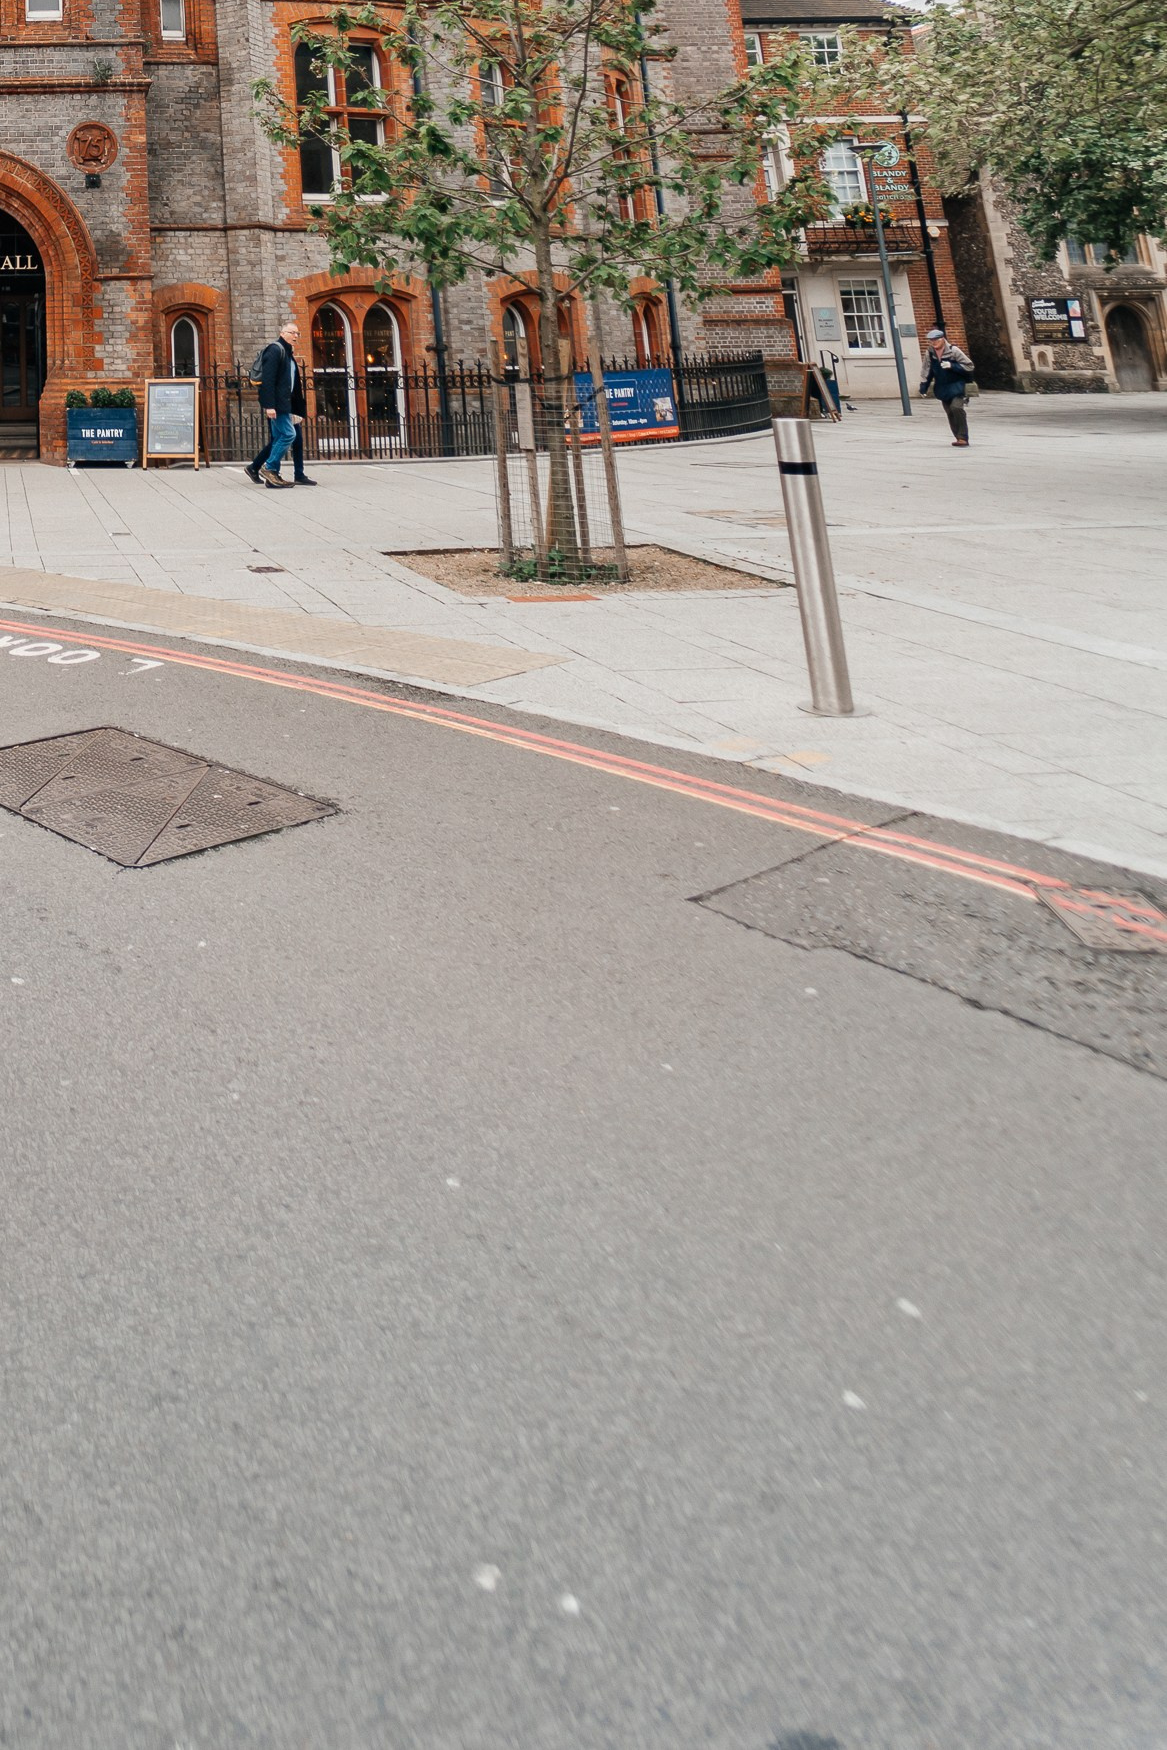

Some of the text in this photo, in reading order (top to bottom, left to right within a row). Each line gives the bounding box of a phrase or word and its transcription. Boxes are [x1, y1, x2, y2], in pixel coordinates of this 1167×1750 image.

[80, 135, 103, 157] 75
[614, 387, 634, 398] PANTRY
[82, 429, 123, 438] THE PANTRY
